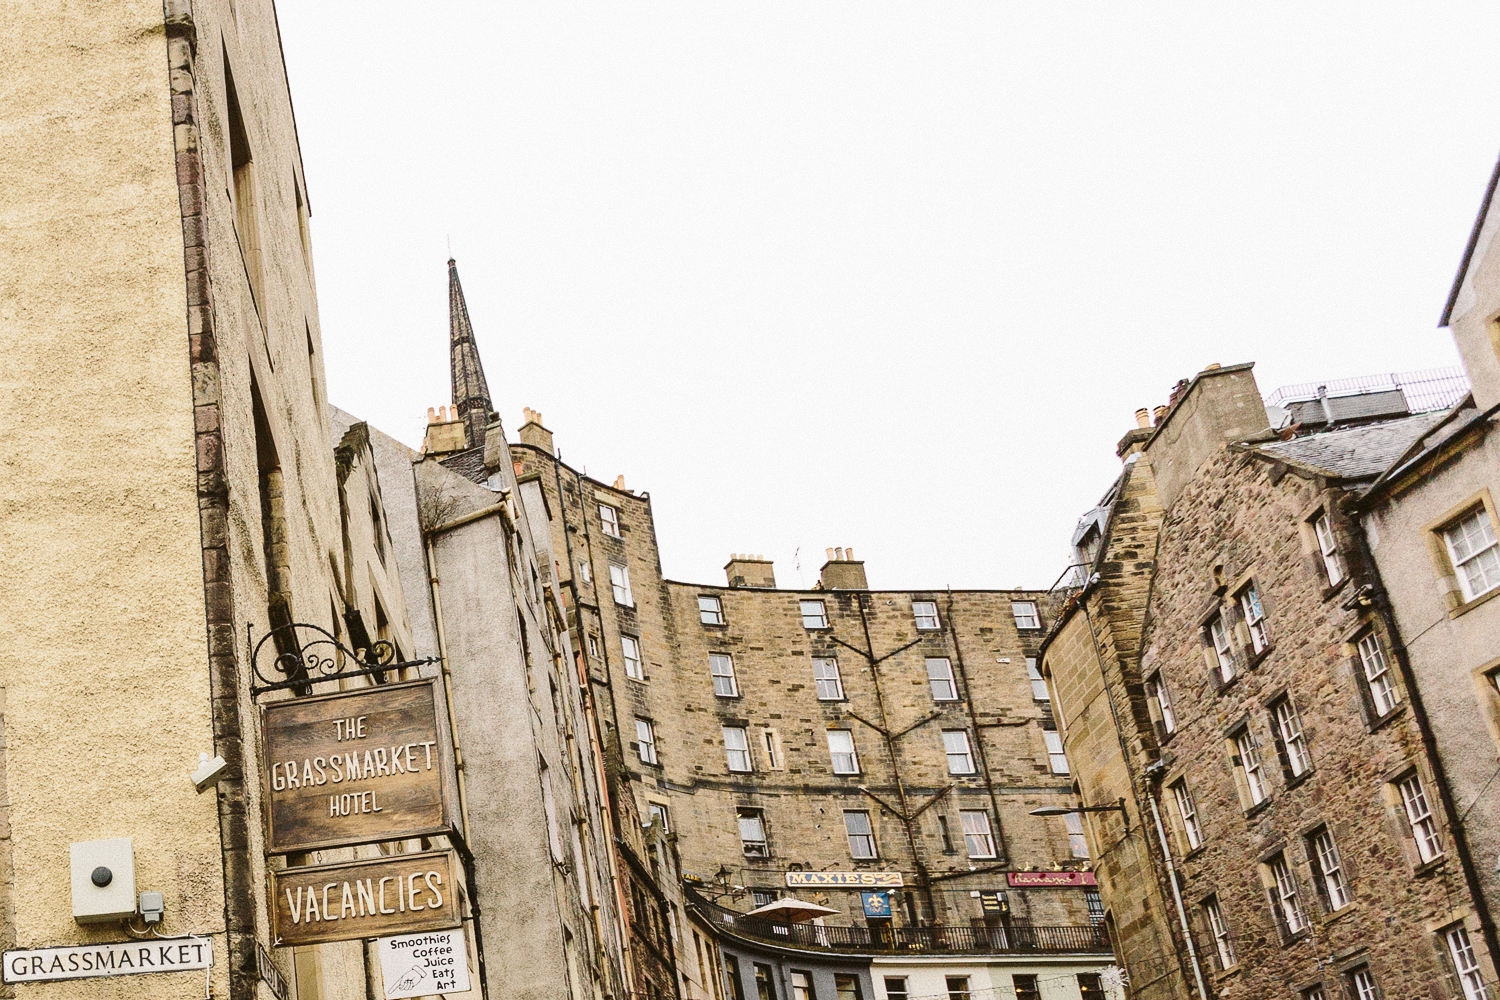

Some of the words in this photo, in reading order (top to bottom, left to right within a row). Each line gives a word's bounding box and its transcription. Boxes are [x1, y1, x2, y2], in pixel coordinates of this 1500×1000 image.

[332, 716, 367, 741] THE
[272, 740, 436, 792] GRASSMARKET
[329, 790, 383, 818] HOTEL
[791, 873, 875, 885] MAXIES
[285, 870, 444, 925] VACANCIES
[390, 934, 451, 950] Smoothies
[412, 946, 453, 958] Coffee
[11, 944, 208, 977] GRASSMARKET
[423, 957, 454, 968] Juice
[432, 968, 455, 979] Eats
[436, 980, 457, 990] Art
